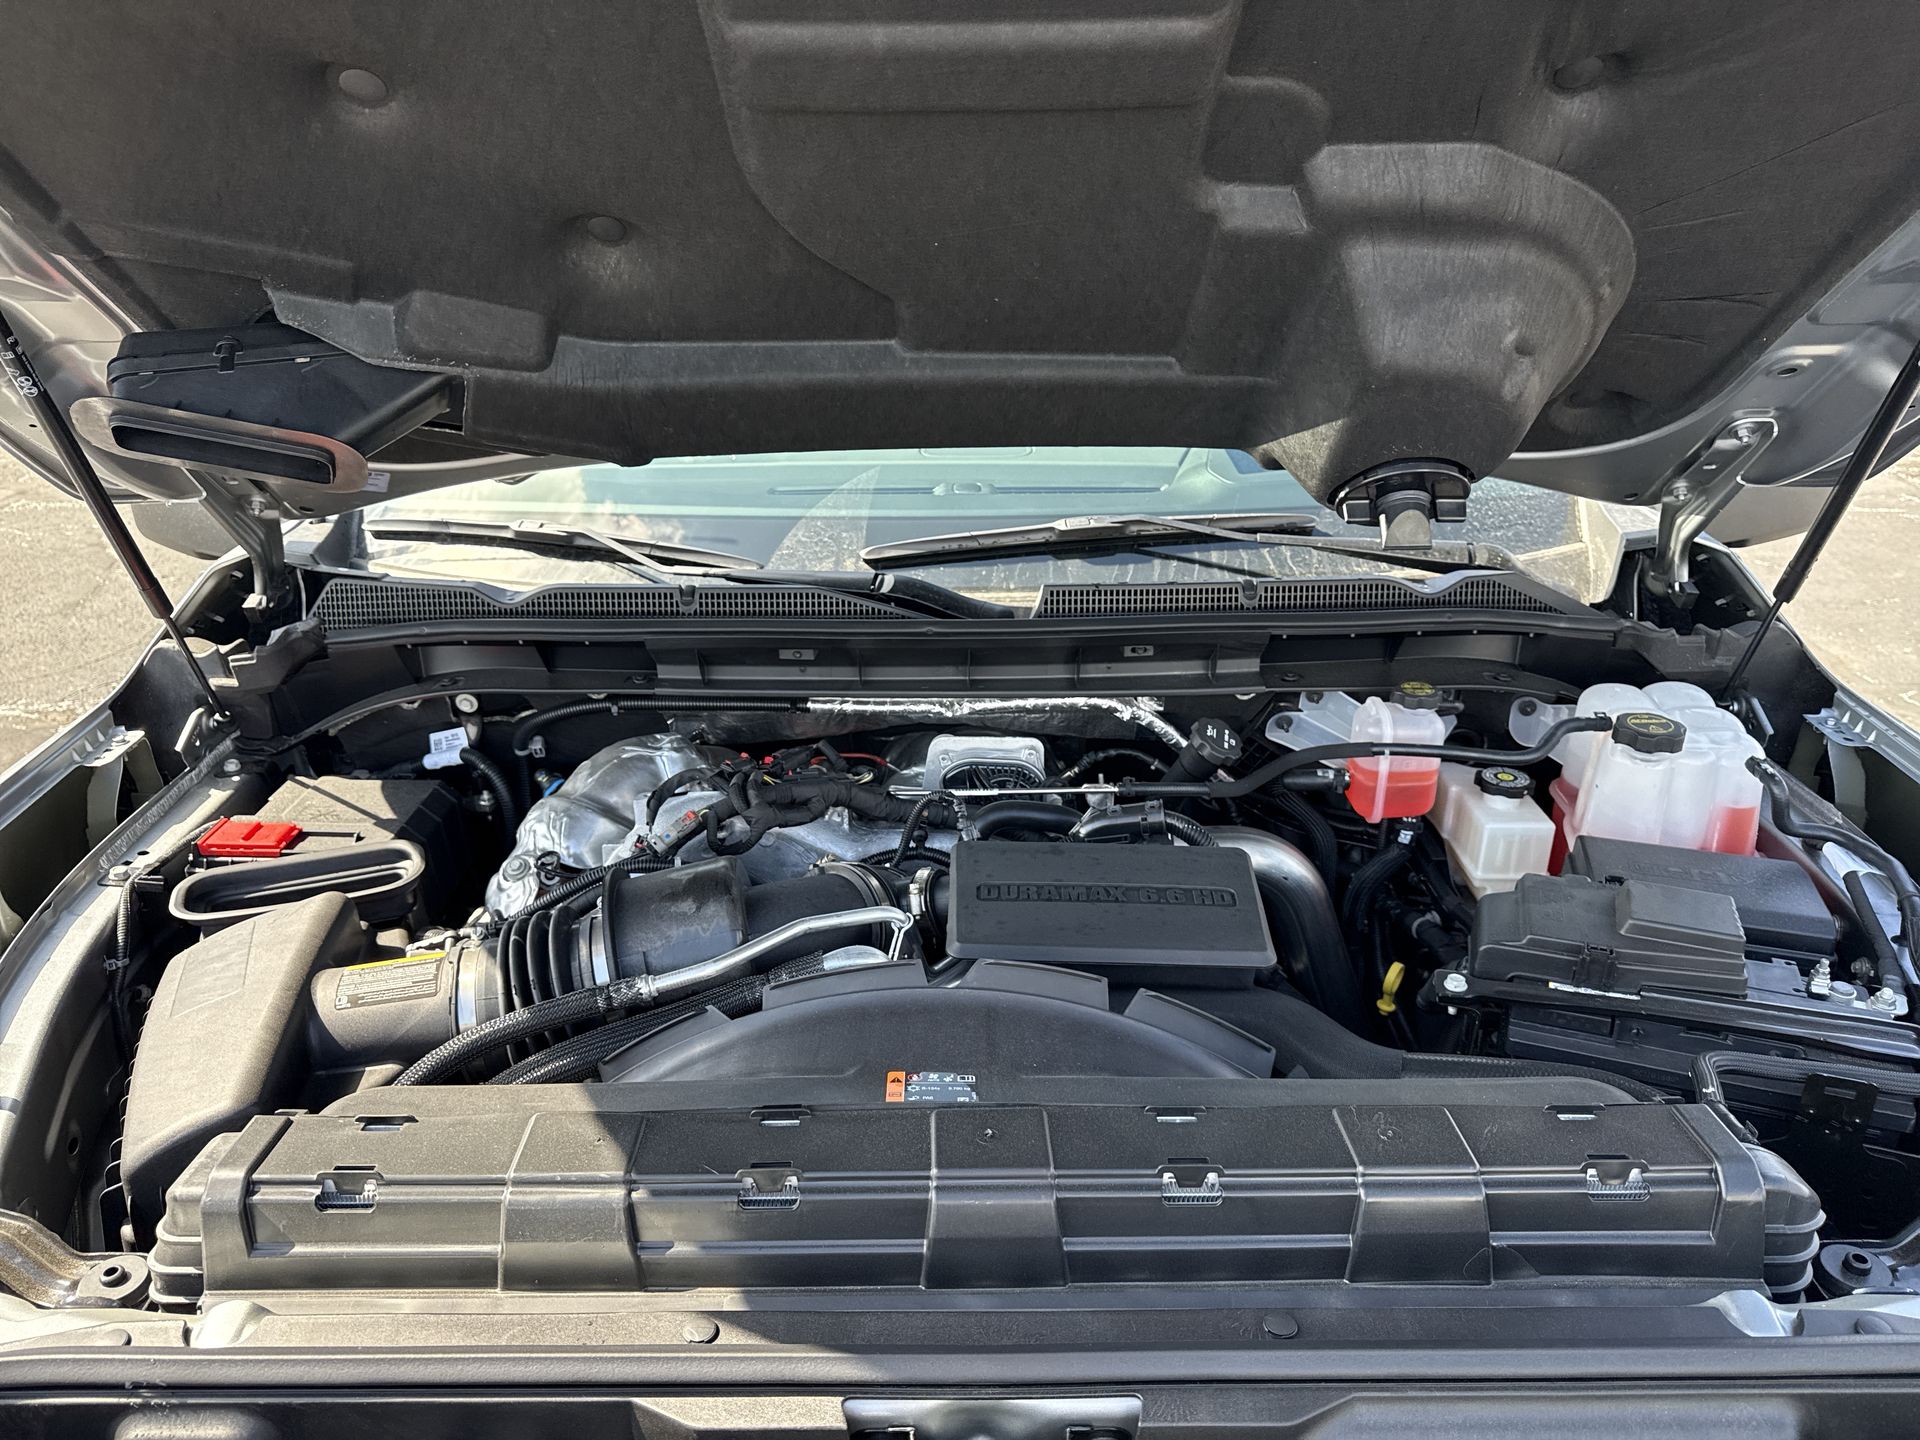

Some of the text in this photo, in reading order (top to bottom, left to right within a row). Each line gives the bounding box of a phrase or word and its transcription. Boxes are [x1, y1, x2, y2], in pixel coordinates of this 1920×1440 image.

[980, 884, 1234, 906] DURAMAX 6.6 HD
